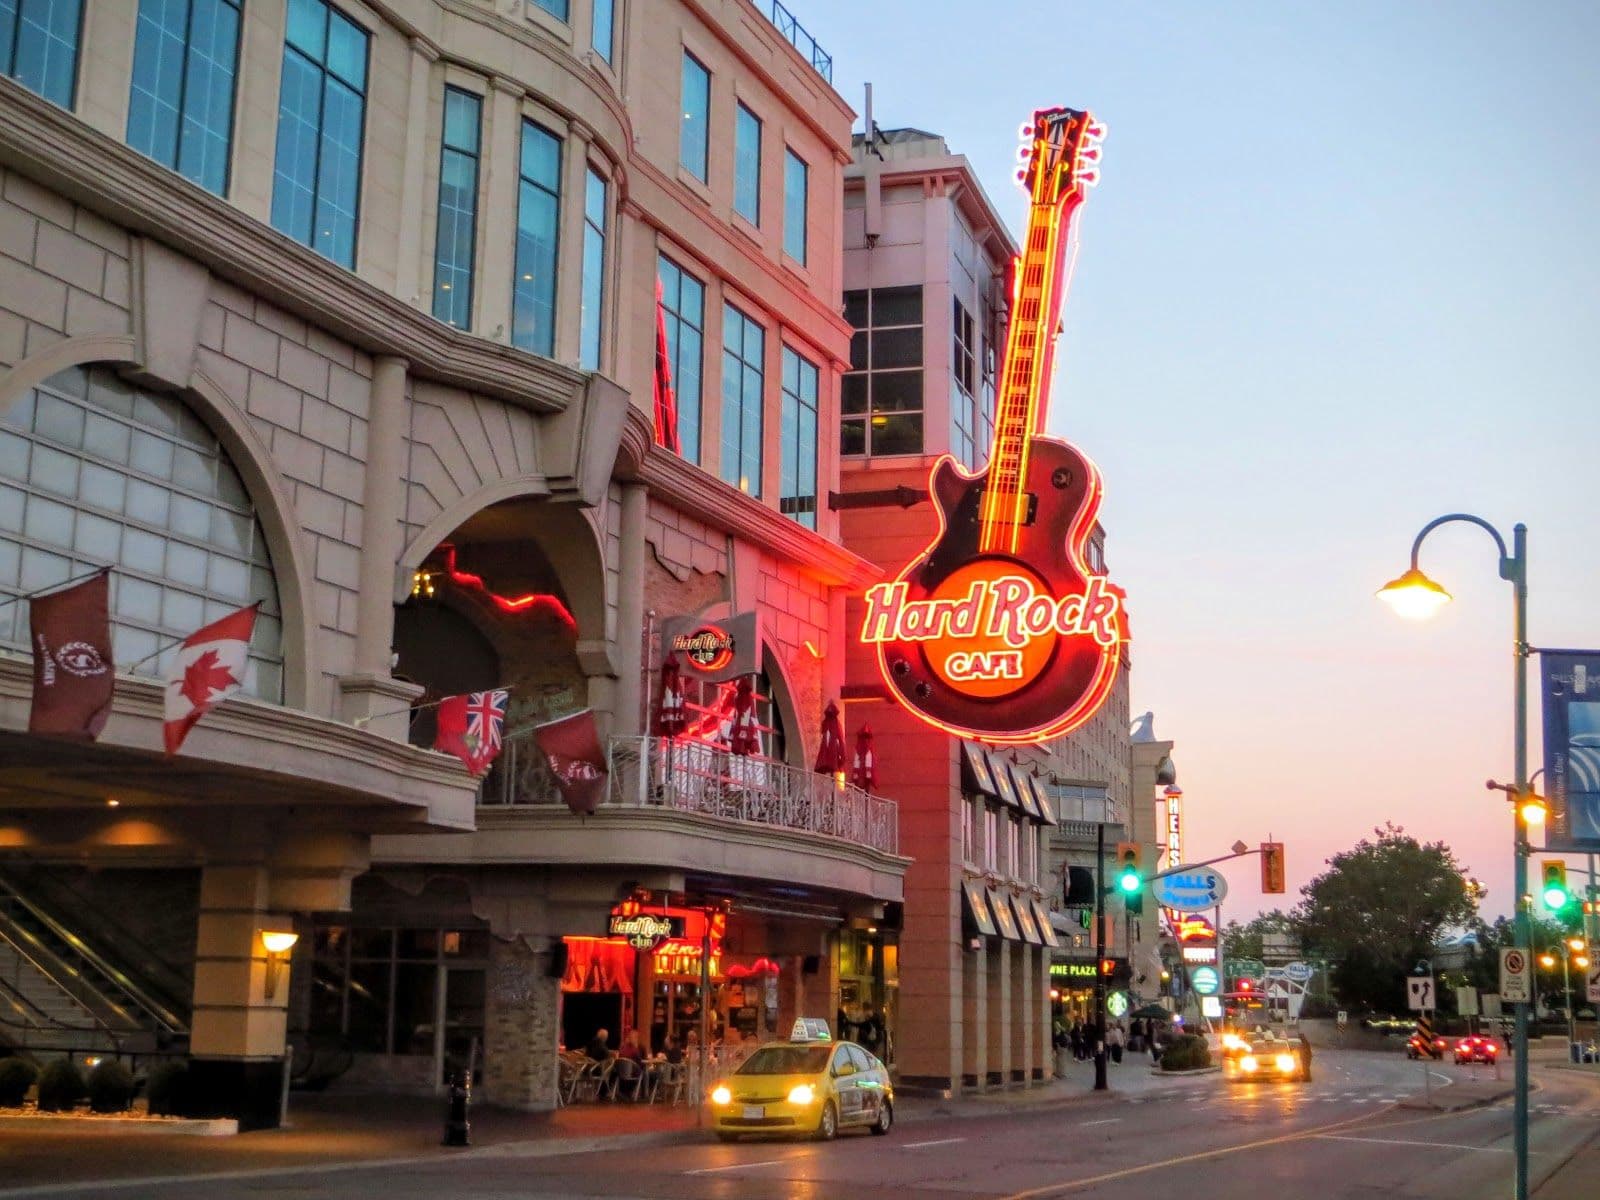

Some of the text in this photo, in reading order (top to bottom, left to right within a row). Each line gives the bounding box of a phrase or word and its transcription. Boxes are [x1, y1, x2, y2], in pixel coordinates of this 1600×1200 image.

[861, 576, 1117, 647] Hard Rock
[945, 651, 1022, 680] CAFE
[610, 916, 671, 938] Hard Rock
[1070, 964, 1097, 976] PLAZA
